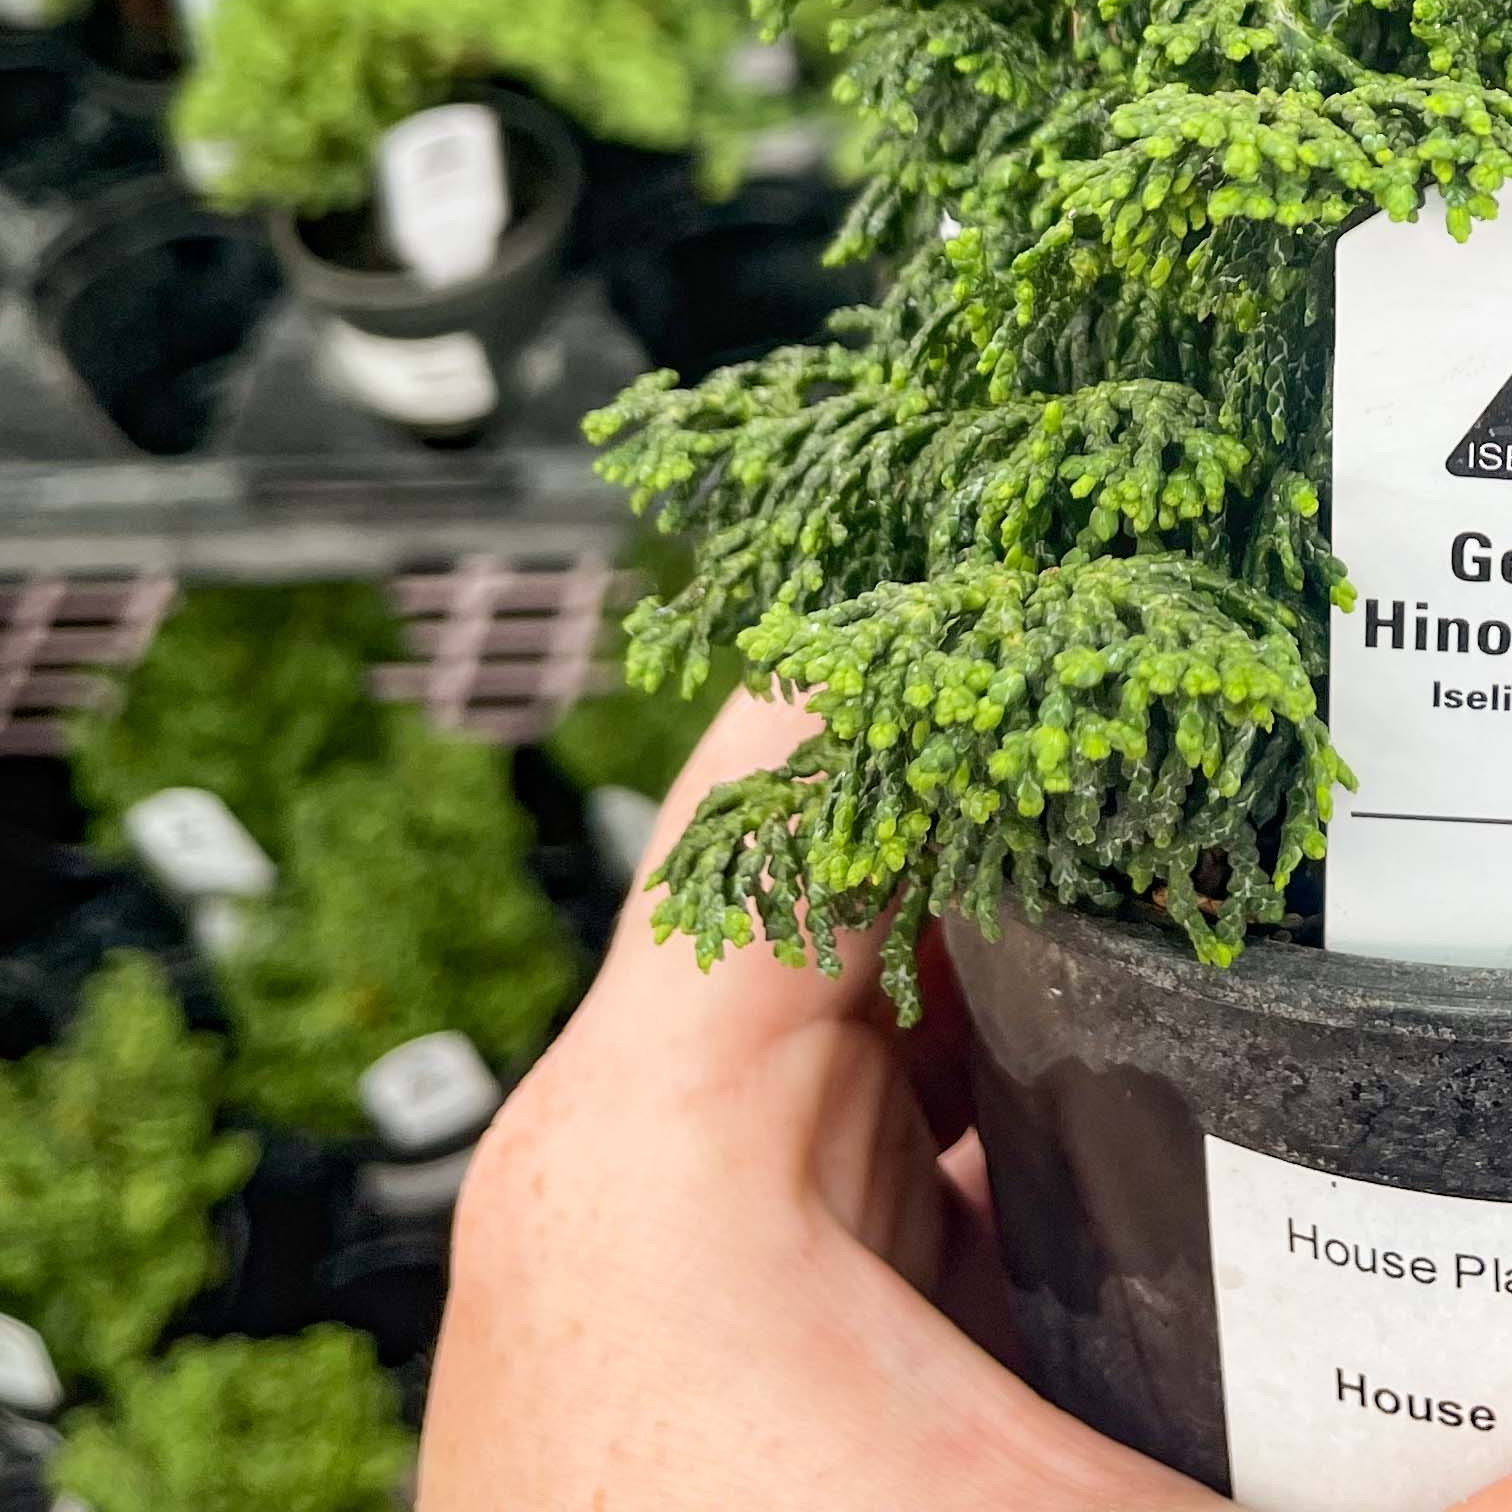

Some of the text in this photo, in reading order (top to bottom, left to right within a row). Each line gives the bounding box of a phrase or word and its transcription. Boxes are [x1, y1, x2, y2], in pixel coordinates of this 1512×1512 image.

[1431, 680, 1512, 712] Iseli
[1286, 1217, 1438, 1285] House
[1334, 1367, 1497, 1433] House
